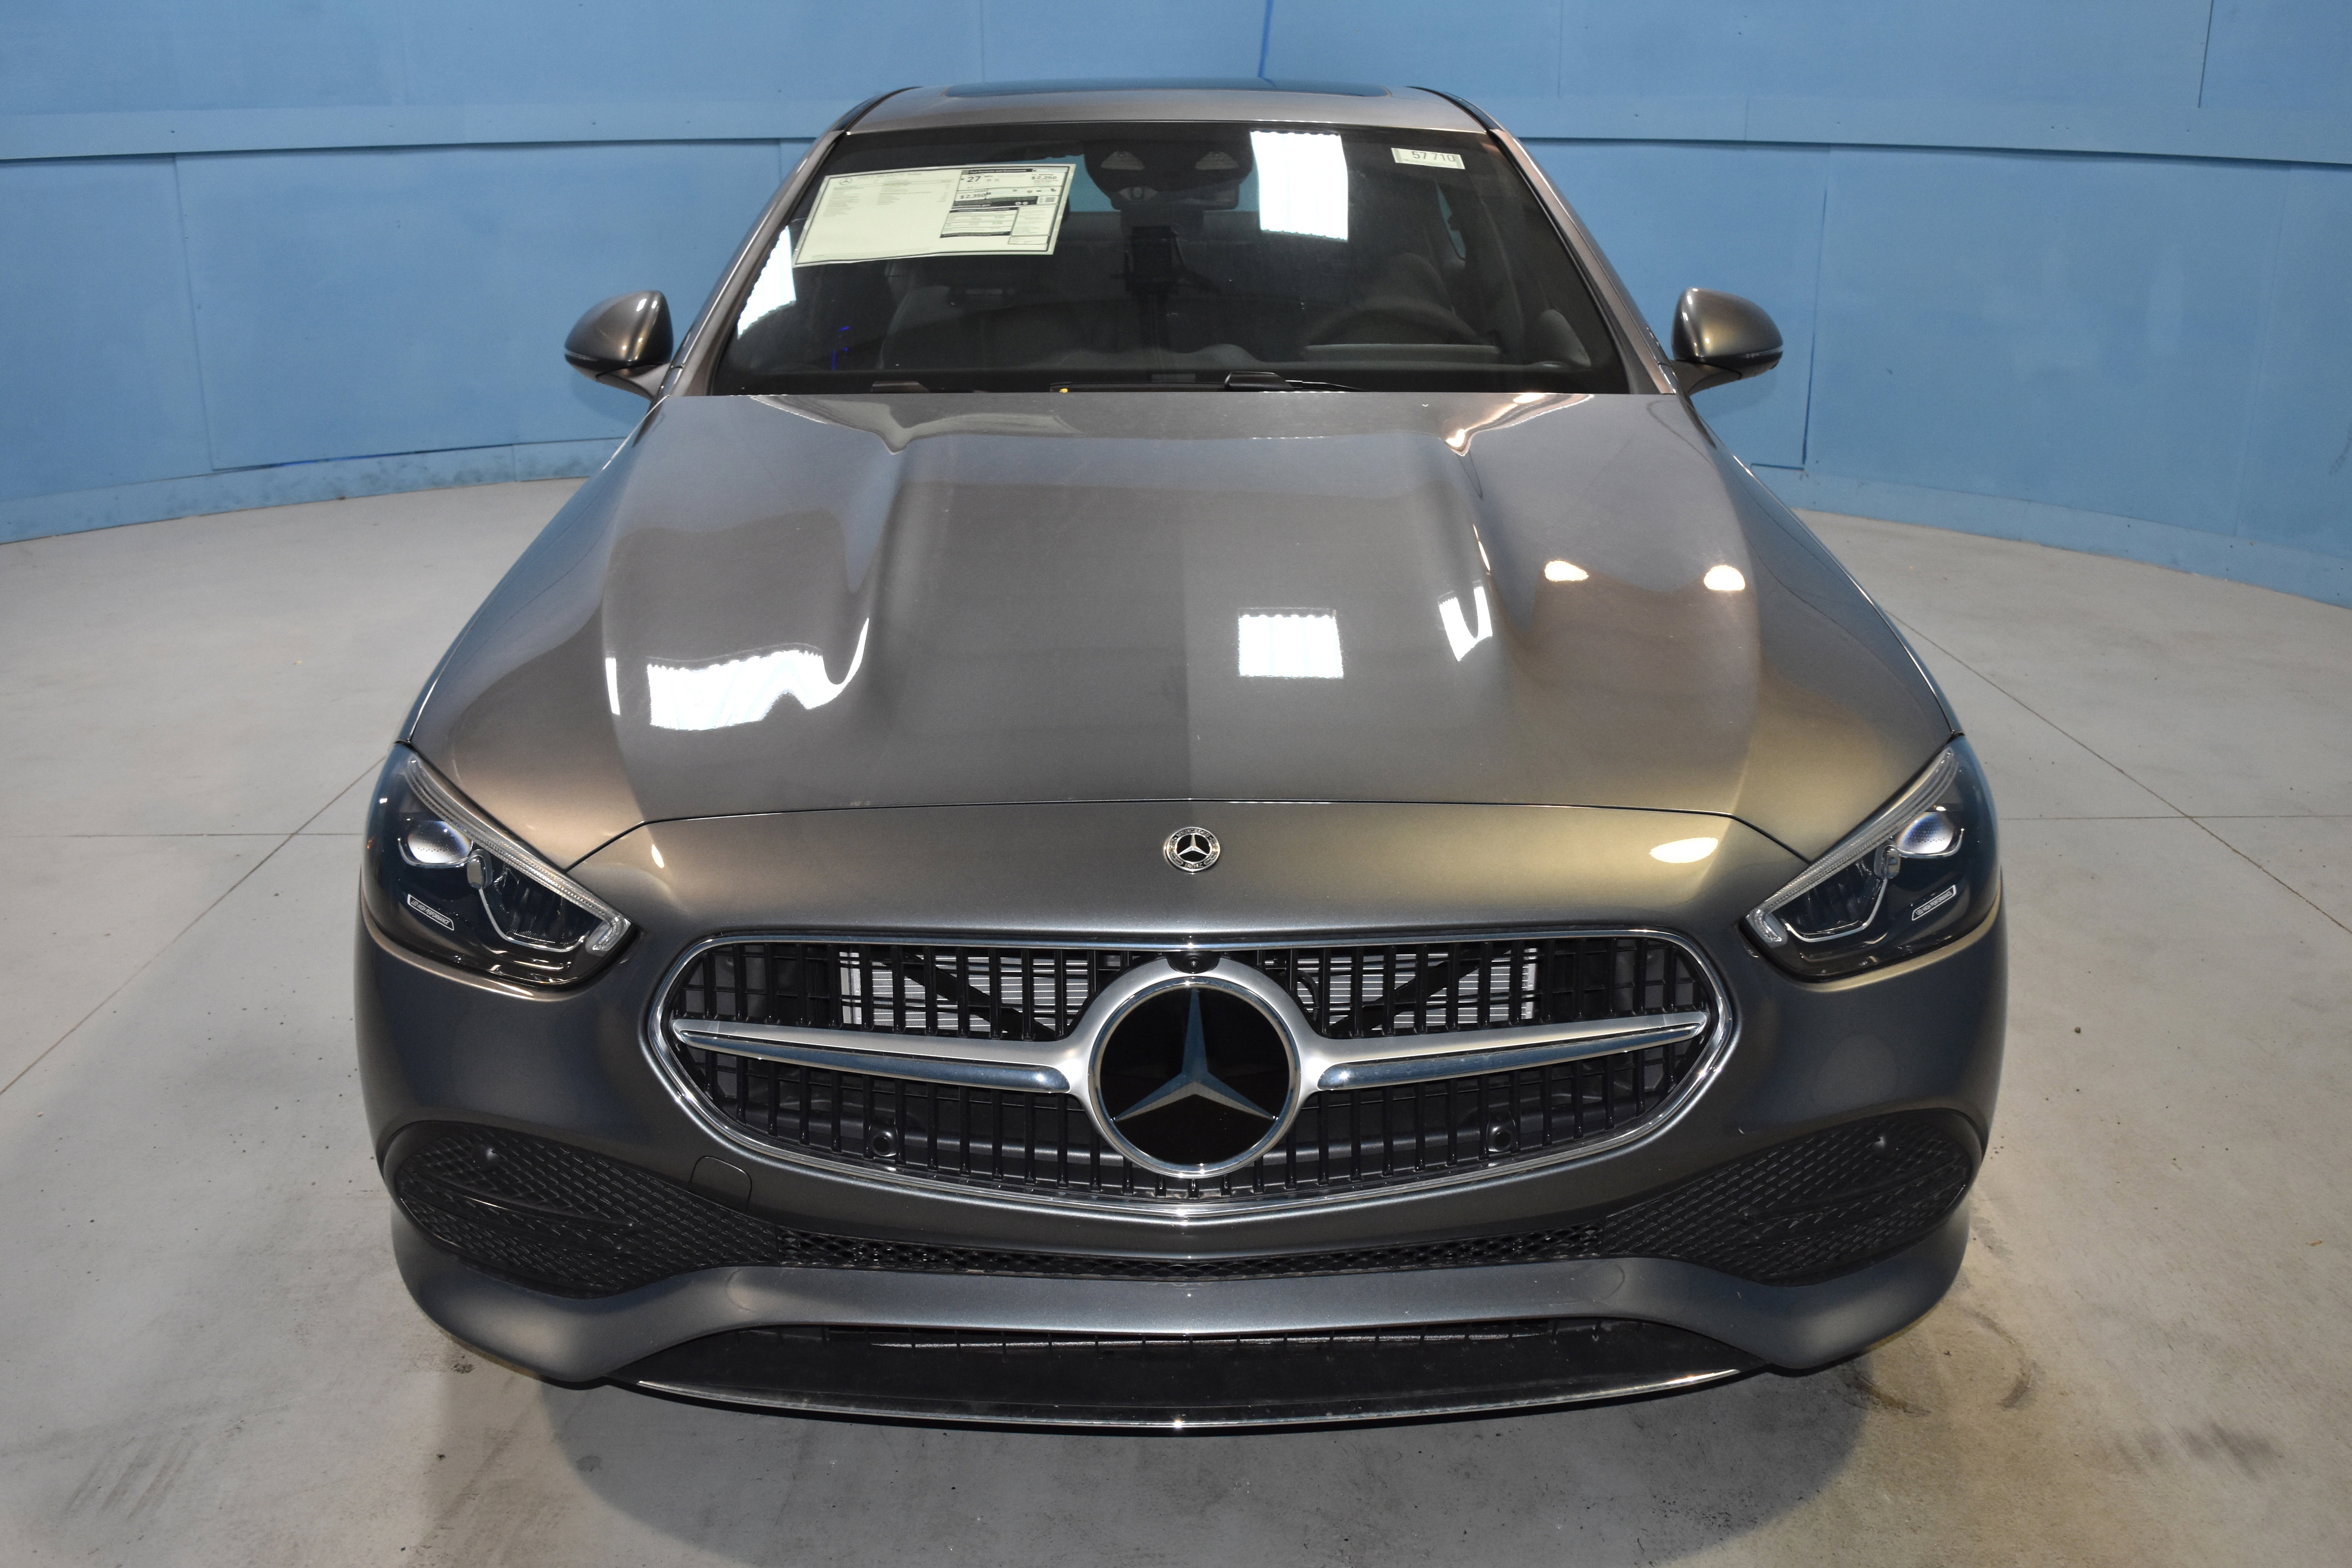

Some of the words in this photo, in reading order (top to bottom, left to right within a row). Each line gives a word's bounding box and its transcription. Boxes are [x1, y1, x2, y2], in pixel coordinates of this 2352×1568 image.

[1176, 829, 1210, 837] MERCEDES
[417, 904, 427, 912] HIGH
[425, 909, 450, 925] PERFORMANCE
